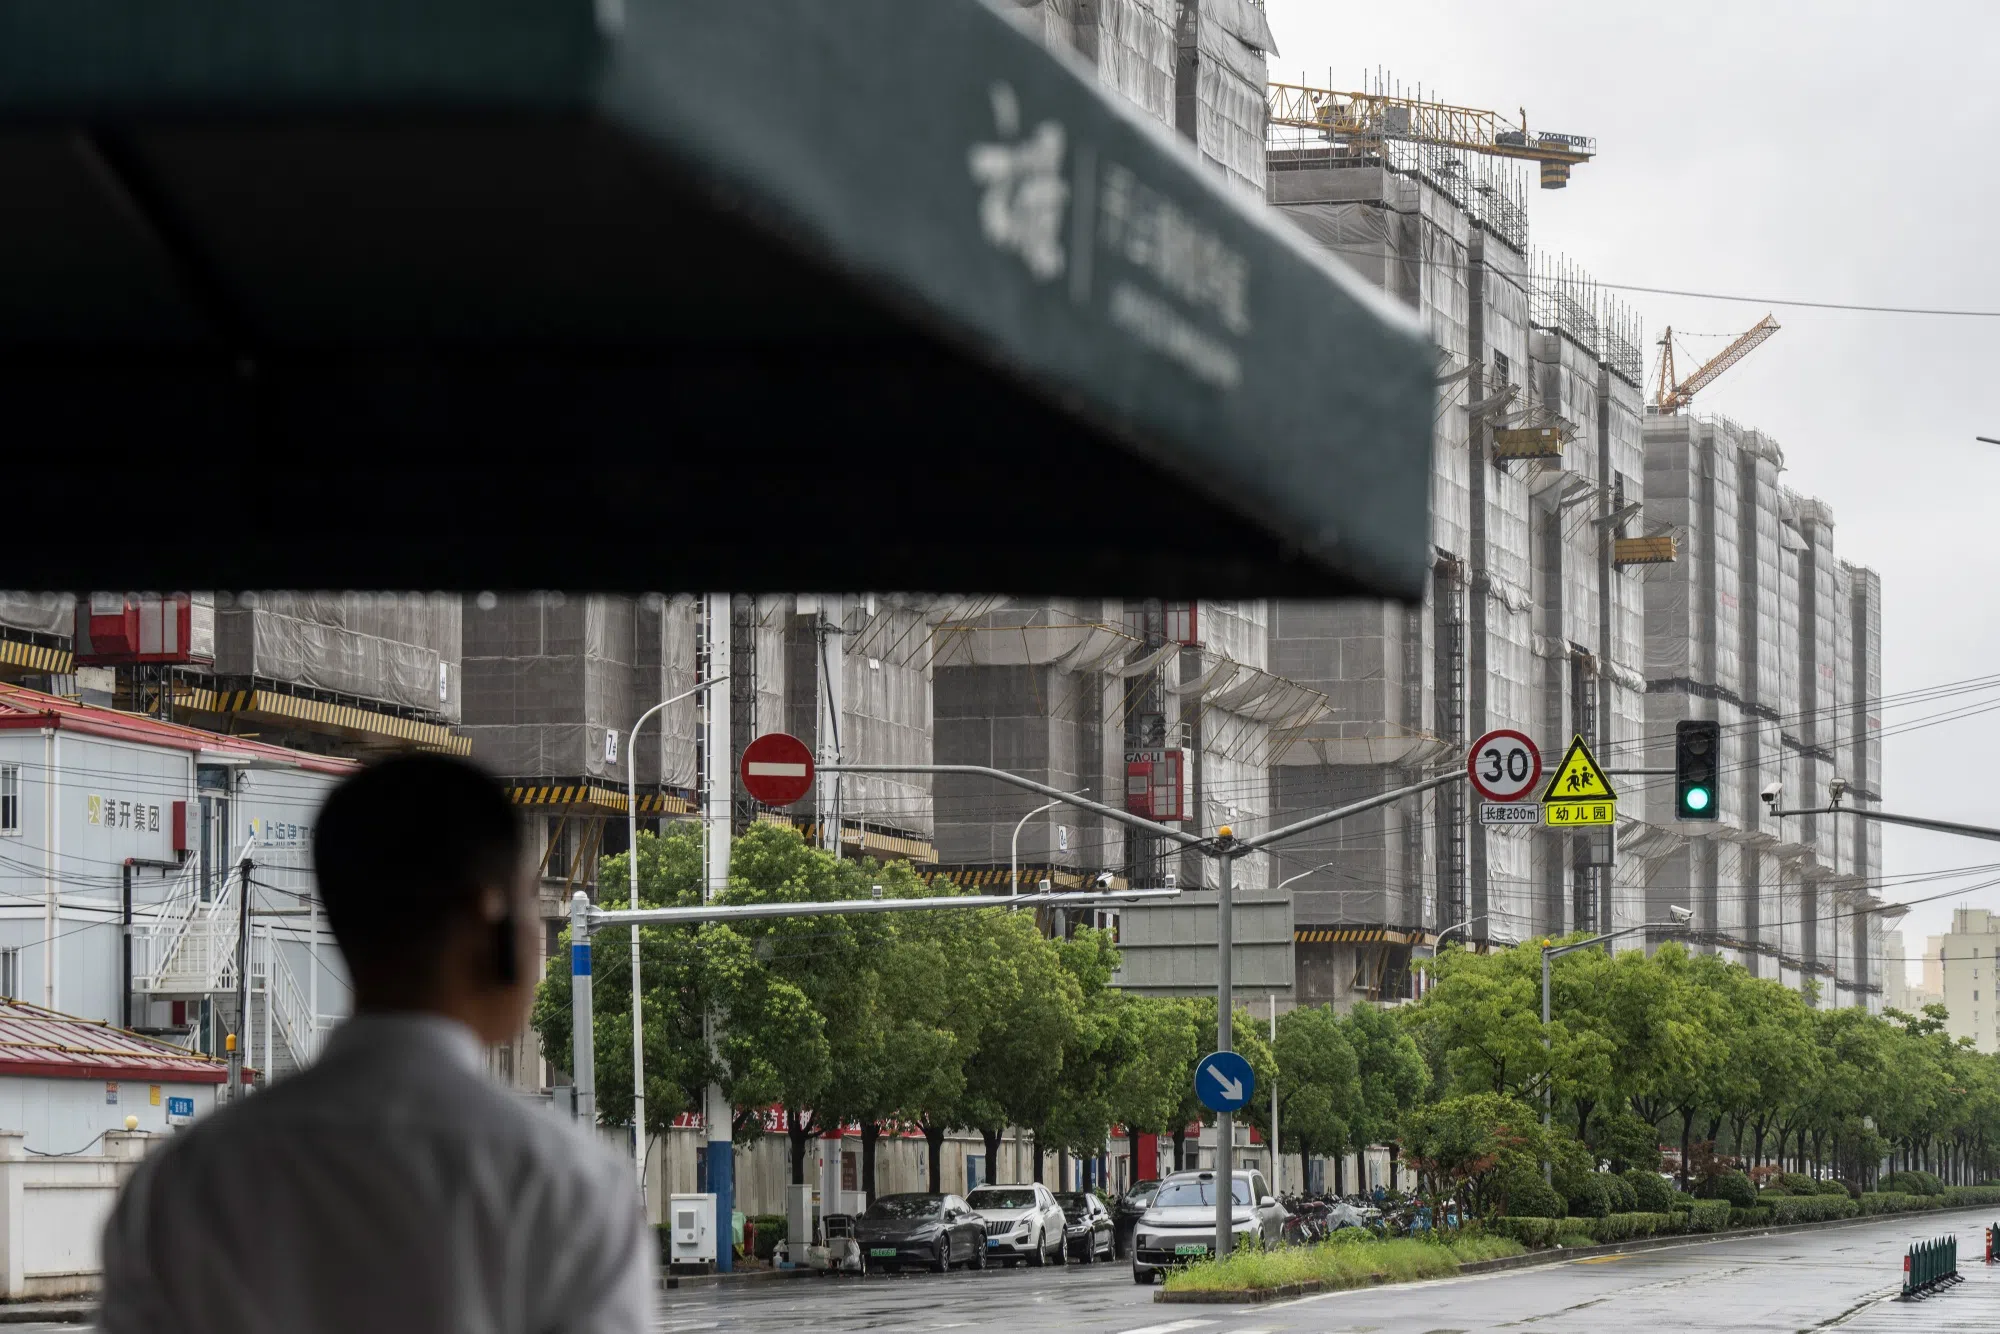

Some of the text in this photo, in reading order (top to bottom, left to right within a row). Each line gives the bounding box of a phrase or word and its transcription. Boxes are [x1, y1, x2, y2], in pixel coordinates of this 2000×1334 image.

[1124, 752, 1160, 762] GAOLI
[1483, 748, 1528, 782] 30
[104, 799, 160, 833] 浦开集团
[1486, 806, 1536, 821] 长度200m
[1556, 806, 1606, 821] 幼儿园
